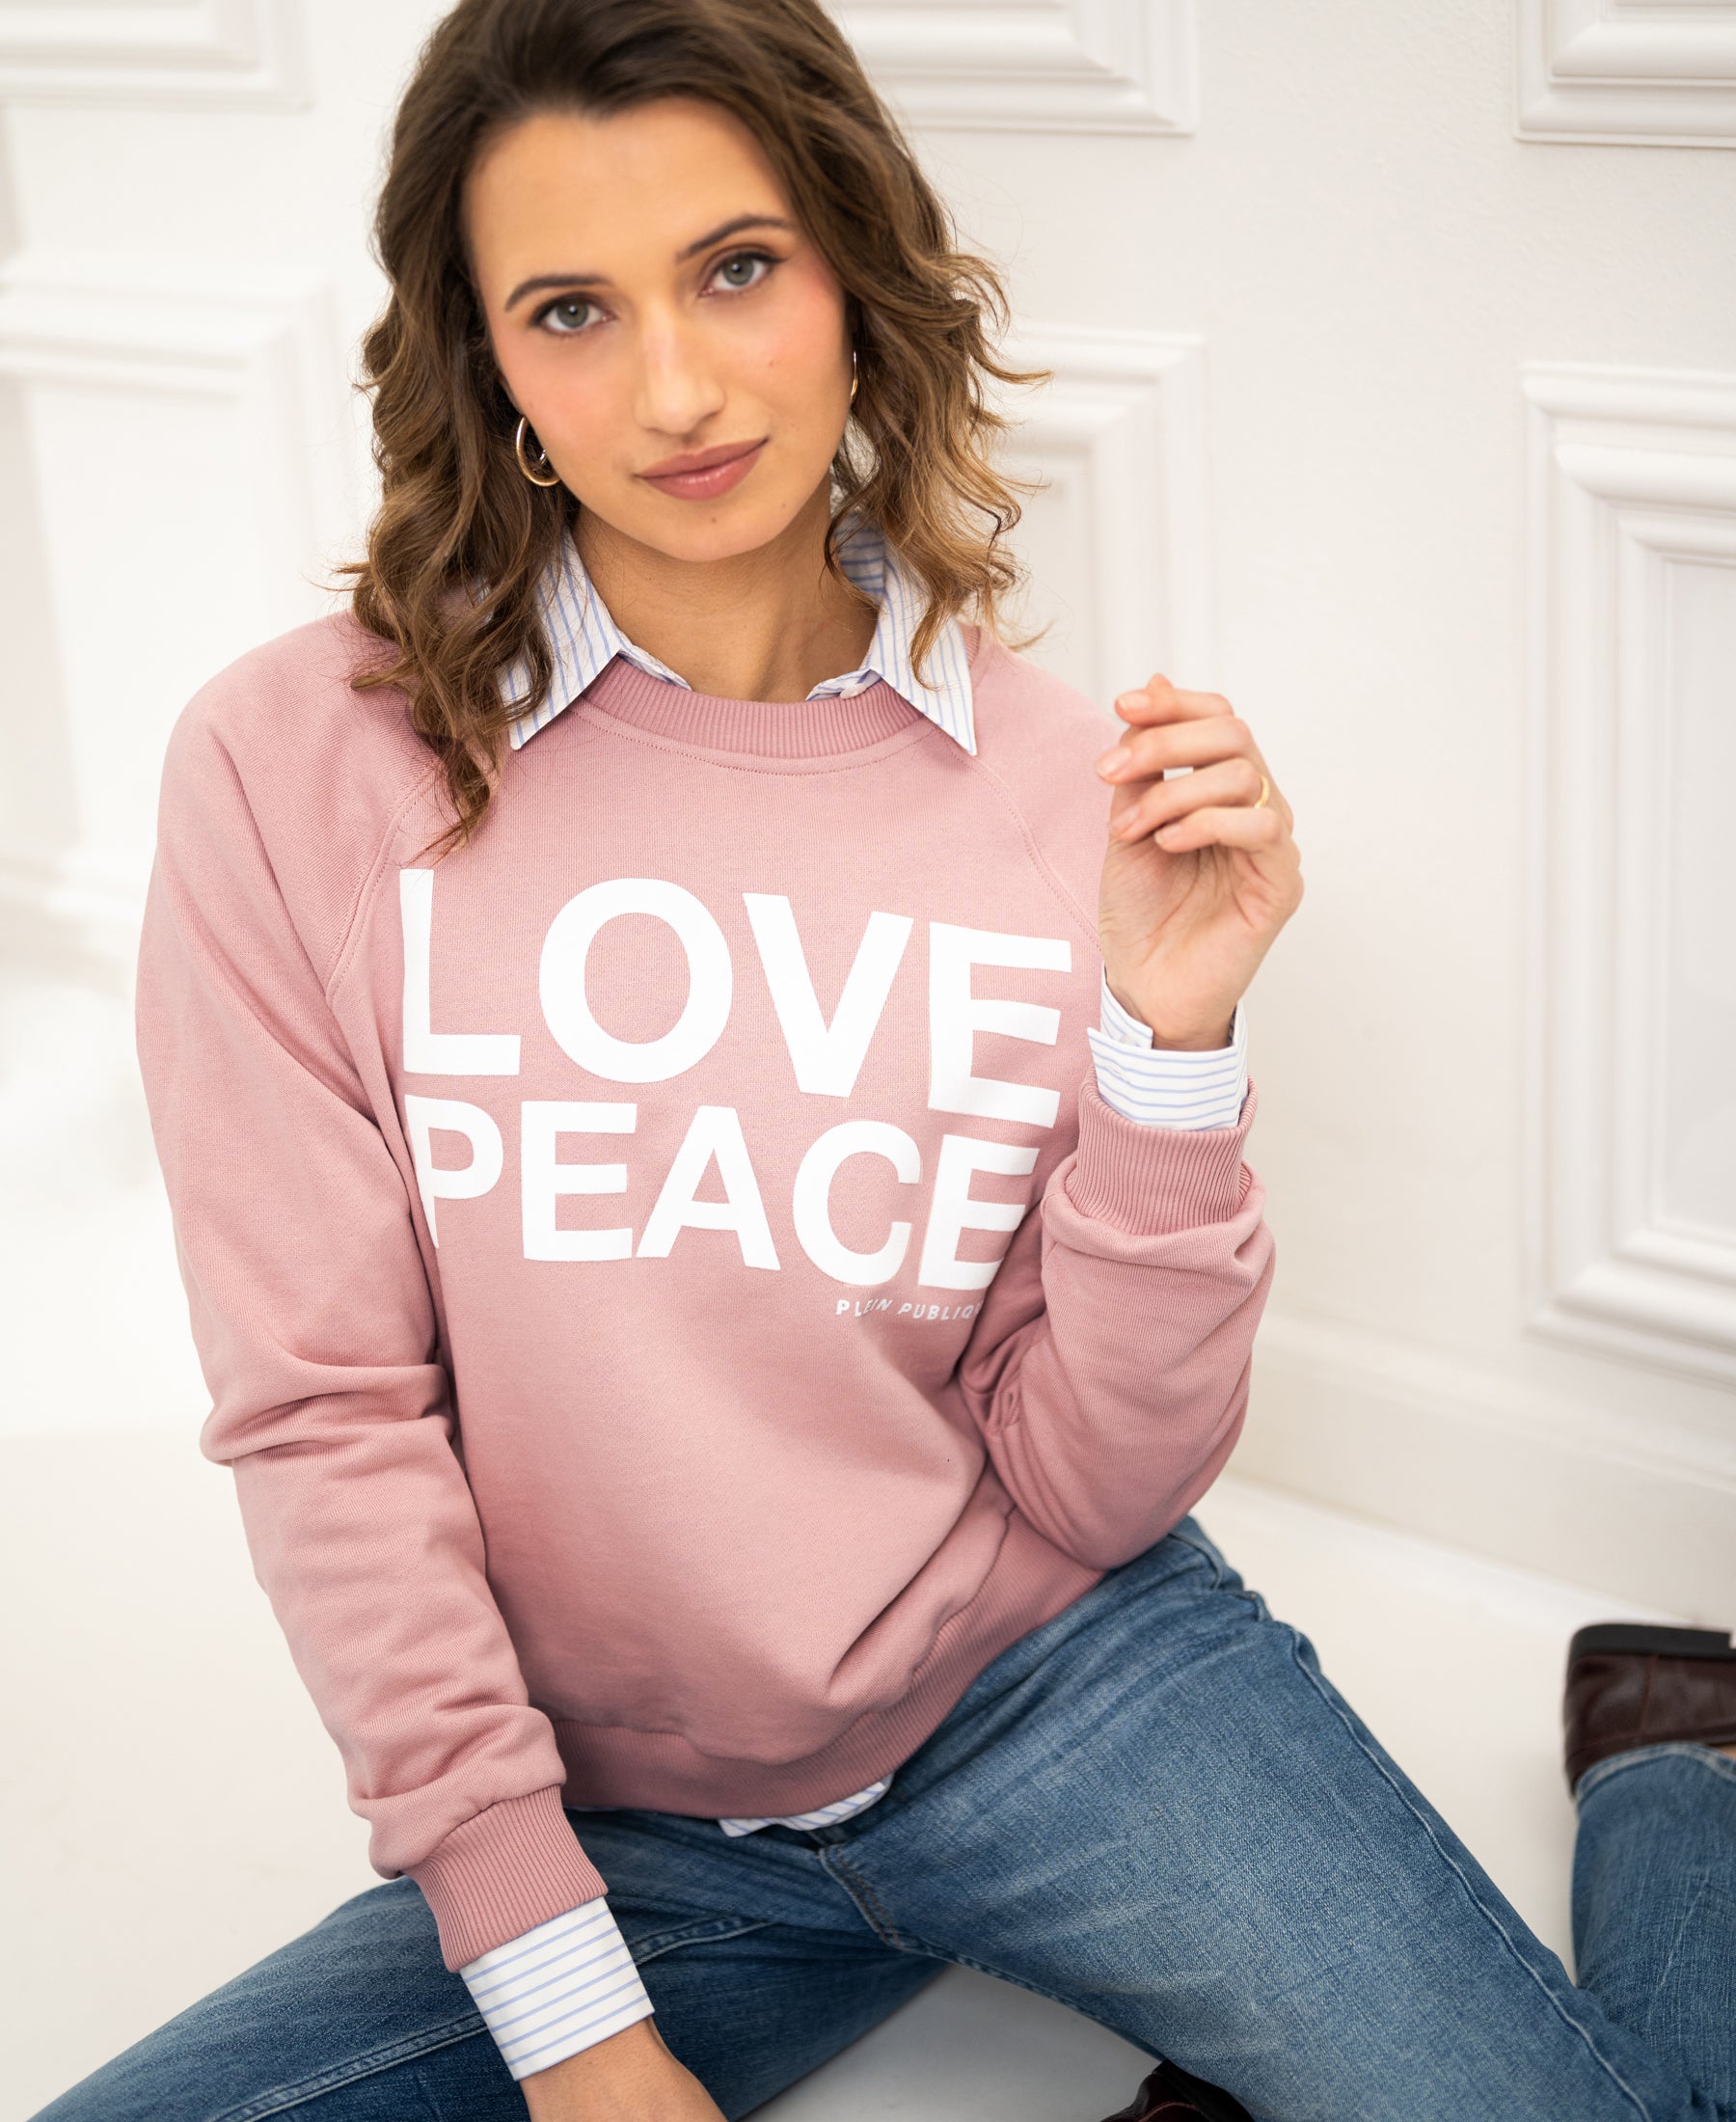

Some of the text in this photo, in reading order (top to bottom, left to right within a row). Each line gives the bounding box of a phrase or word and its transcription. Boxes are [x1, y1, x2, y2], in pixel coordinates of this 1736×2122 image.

[399, 868, 1072, 1129] LOVE
[404, 1094, 1041, 1291] PEACE
[835, 1298, 893, 1317] PLEIN
